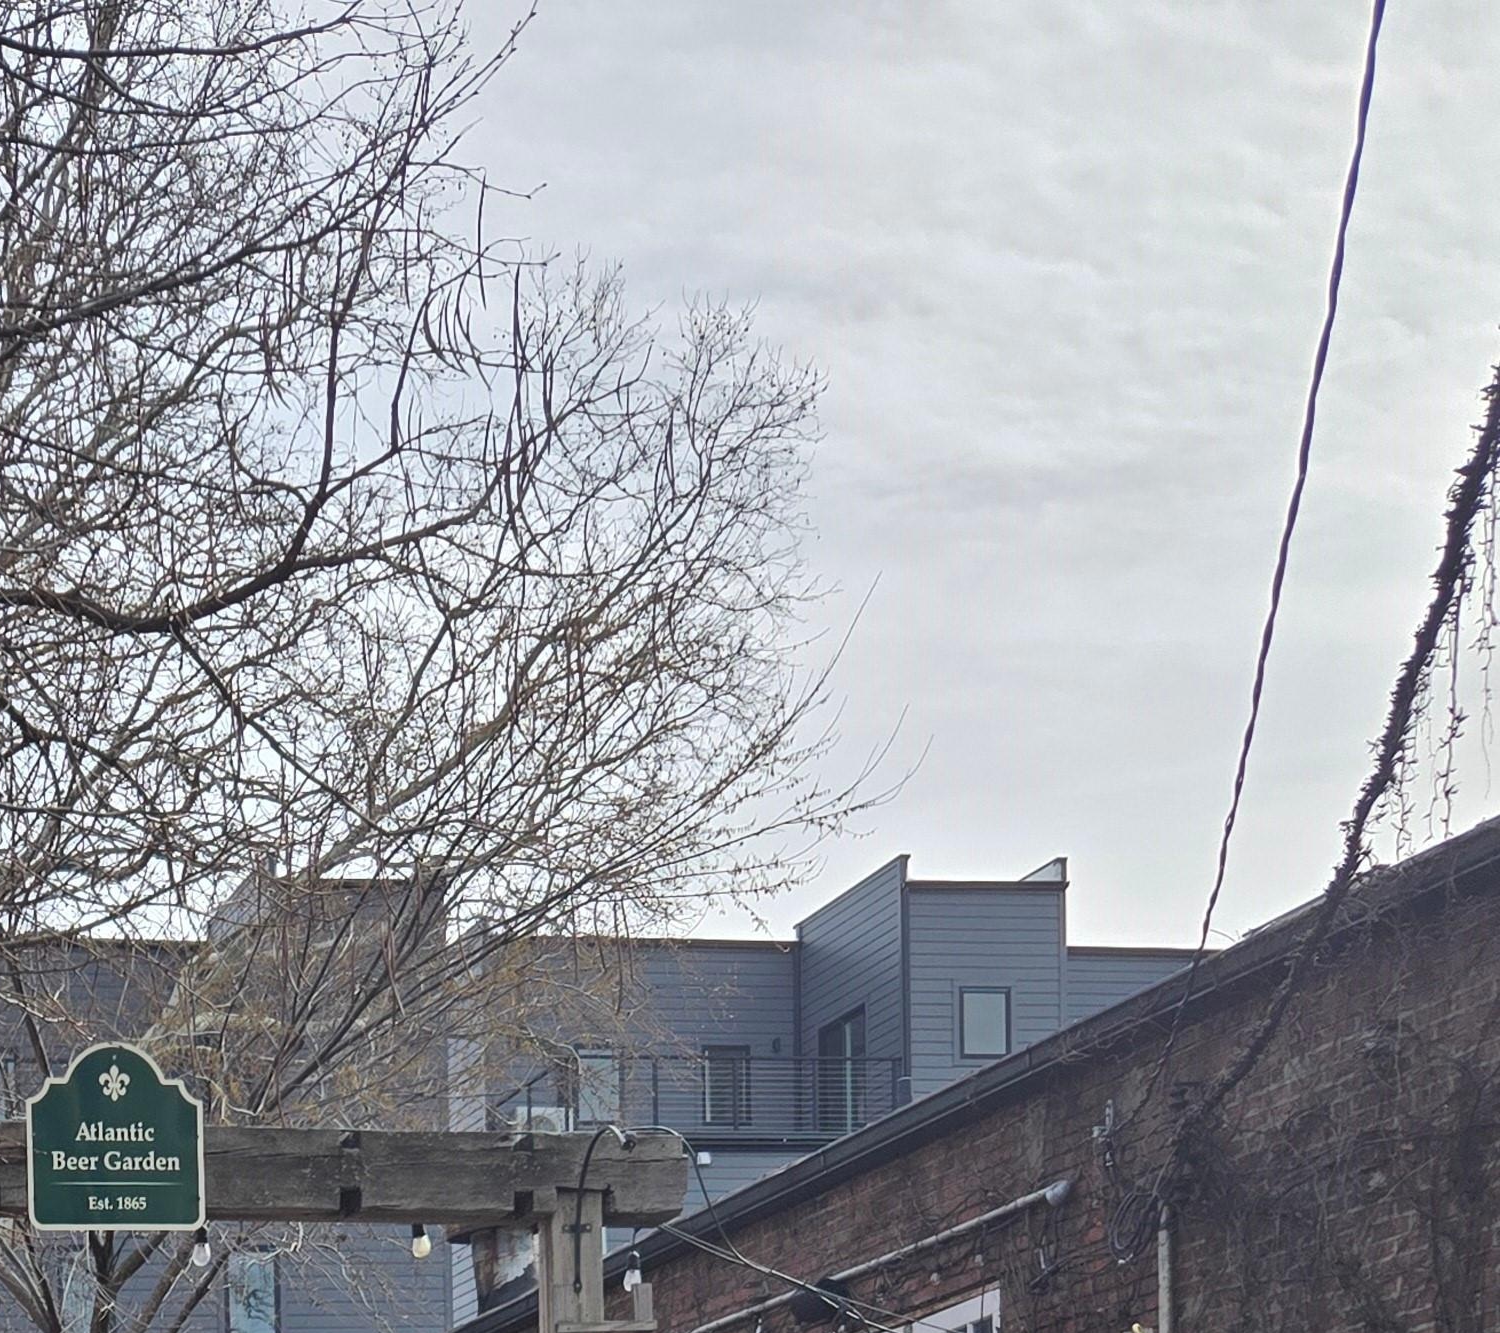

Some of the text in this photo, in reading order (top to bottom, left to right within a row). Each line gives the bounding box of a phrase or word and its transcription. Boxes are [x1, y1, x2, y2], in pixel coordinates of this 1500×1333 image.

[75, 1121, 155, 1142] Atlantic
[51, 1150, 181, 1171] Beer Garden
[88, 1196, 147, 1211] Est. 1865
